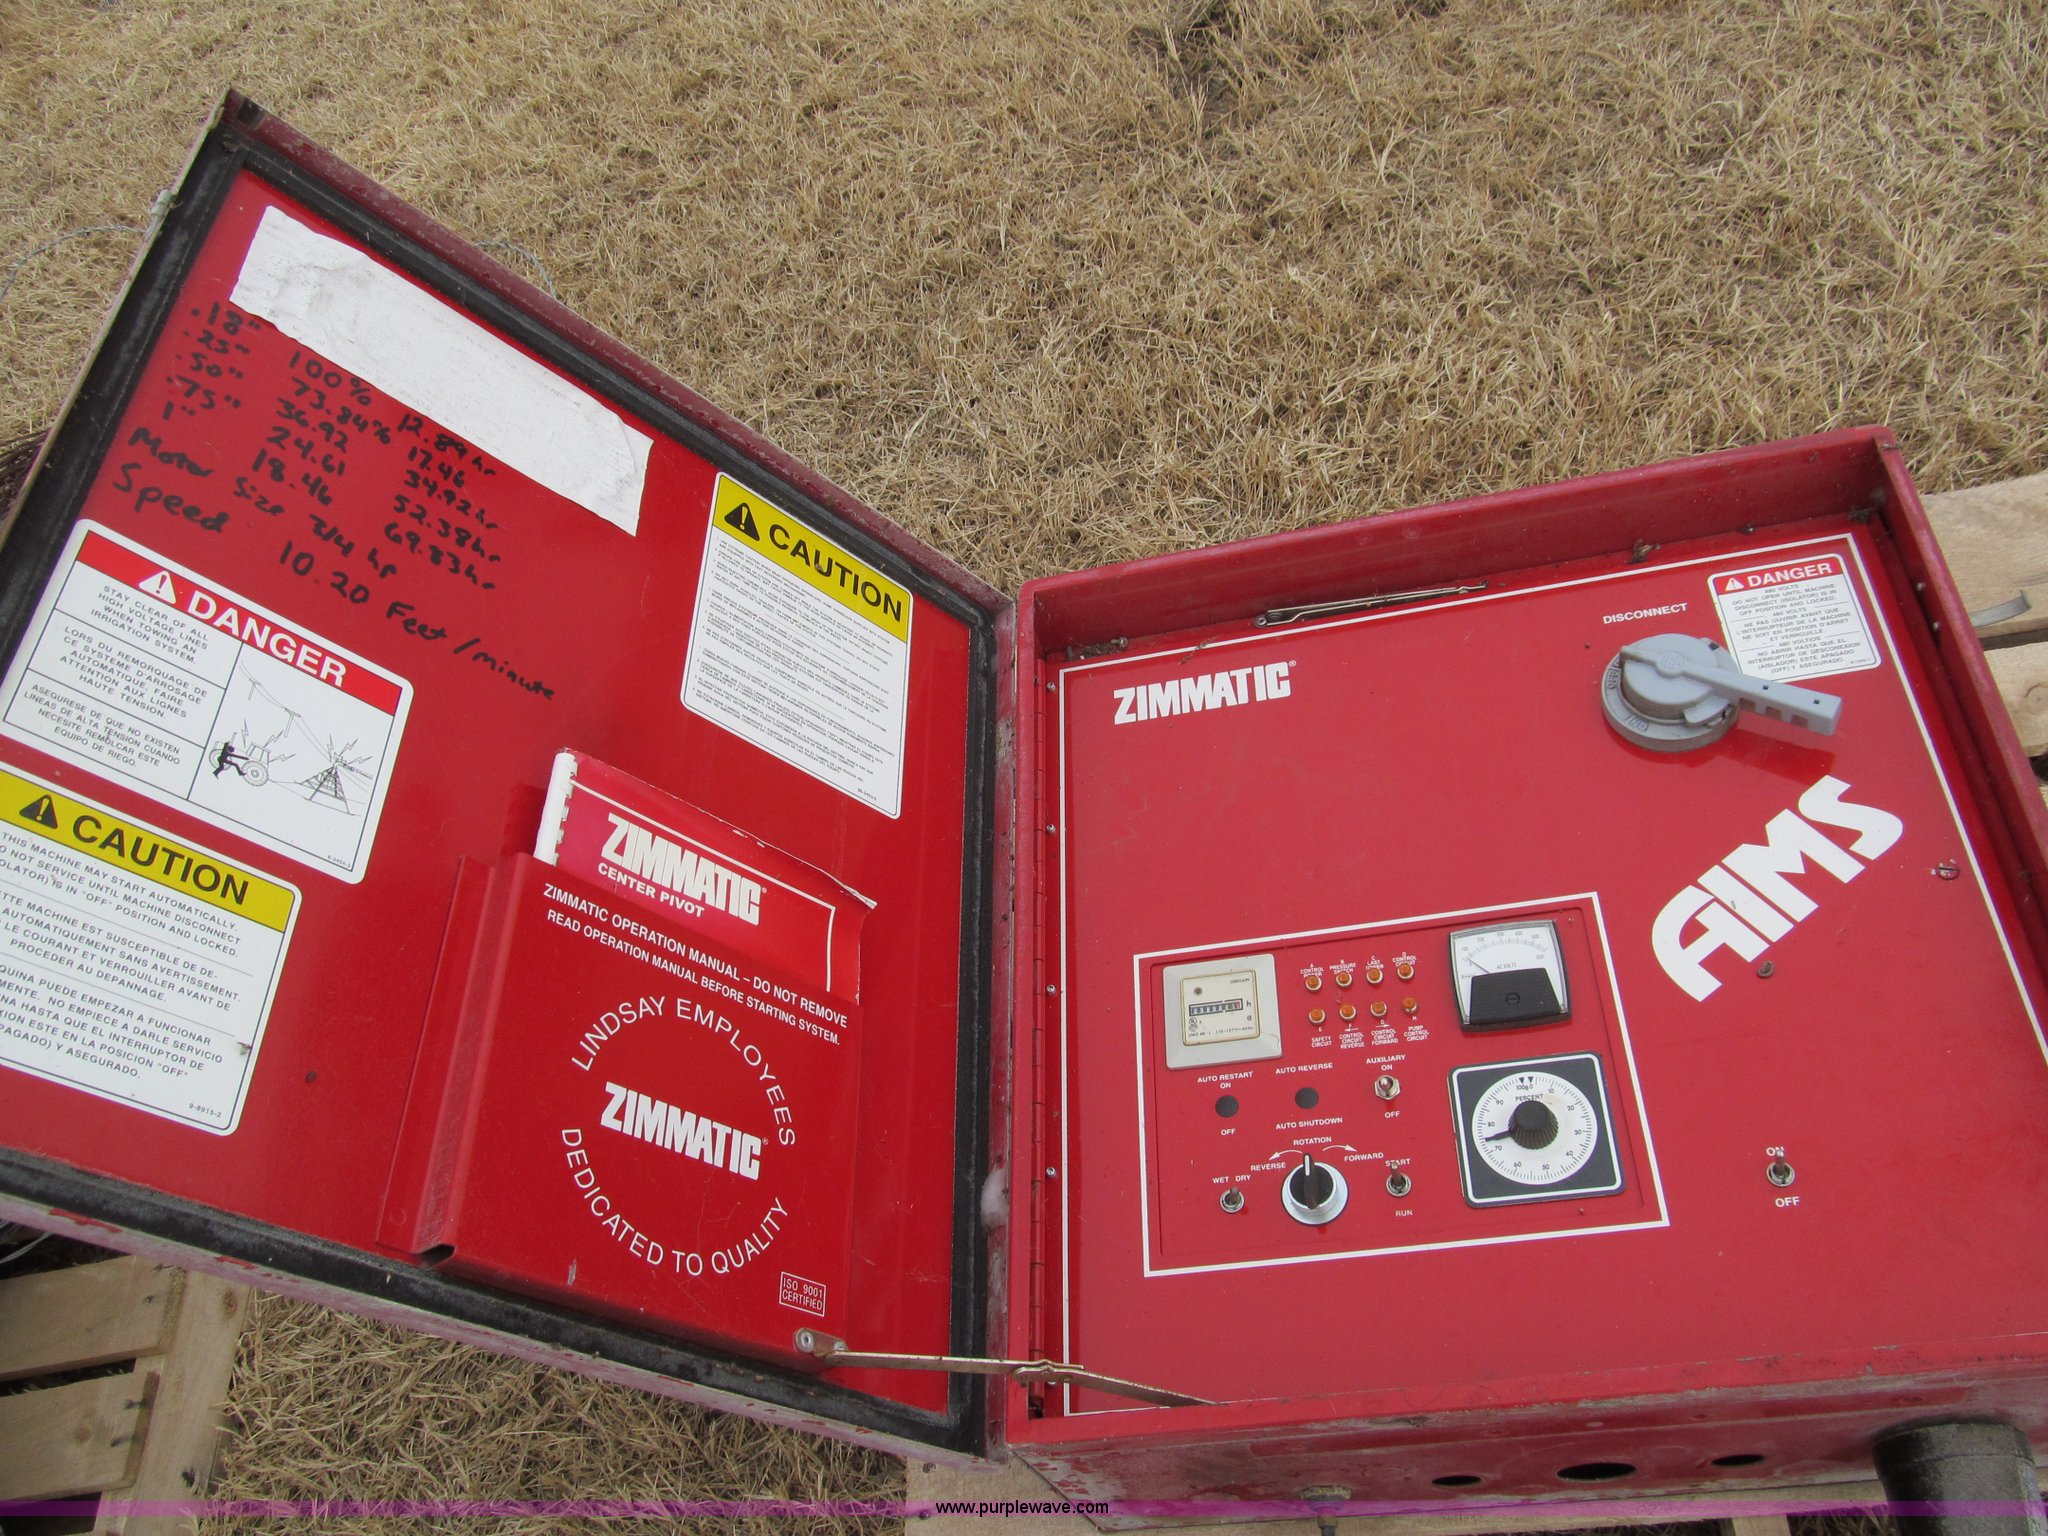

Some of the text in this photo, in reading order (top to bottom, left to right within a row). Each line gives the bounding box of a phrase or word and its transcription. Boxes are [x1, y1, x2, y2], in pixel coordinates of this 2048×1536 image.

[290, 351, 372, 406] 100%
[252, 448, 332, 506] 18.46
[267, 426, 345, 477] 24.61
[113, 462, 230, 533] Speed
[386, 601, 447, 640] Feet
[769, 523, 902, 623] CAUTION
[1748, 562, 1833, 588] DANGER
[90, 609, 196, 664] IRRIGATION SYSTEM.
[98, 592, 208, 650] HIGH VOLTAGE LINES
[103, 585, 208, 642] STAY CLEAR OF ALL
[104, 604, 197, 654] WHEN TOWING AN
[187, 589, 348, 689] DANGER
[1603, 602, 1689, 624] DISCONNECT
[31, 684, 180, 755] ASEGURESE DE QUE NO EXISTEN
[79, 674, 166, 719] HAUTE TENSION.
[1113, 661, 1291, 725] ZIMMATIC
[54, 726, 137, 768] EQUIPO DE RIEGO.
[2, 831, 28, 848] THIS
[30, 843, 82, 870] MACHINE
[84, 865, 109, 879] MAY
[110, 875, 147, 895] START
[148, 891, 237, 932] AUTOMATICALLY.
[72, 814, 249, 906] CAUTION
[600, 812, 761, 926] ZIMMATIC
[10, 849, 241, 945] NOT SERVICE UNTIL MACHINE DISCONNECT
[598, 862, 705, 918] CENTER PIVOT
[1652, 774, 1904, 1002] AIMS
[52, 875, 238, 958] IS IN "OFF" POSITION AND LOCKED.
[10, 938, 166, 1002] PROCEDER AU DEPANNAGE.
[543, 883, 848, 1029] ZIMMATIC OPERATION MANUAL DO NOT REMOVE
[547, 909, 841, 1046] READ OPERATION MANUAL BEFORE STARTING SYSTEM.
[571, 996, 796, 1146] LINDSAY EMPLOYEES
[1197, 1070, 1253, 1083] AUTO RESTART
[1275, 1062, 1333, 1074] AUTO REVERSE
[1366, 1054, 1406, 1064] AUXILIARY
[1275, 1117, 1343, 1130] AUTO SHUTDOWN
[1385, 1111, 1400, 1119] OFF
[1515, 1094, 1544, 1102] PERCENT
[600, 1081, 762, 1180] ZIMMATIC
[1220, 1128, 1236, 1136] OFF
[1293, 1136, 1332, 1146] ROTATION
[1344, 1152, 1384, 1162] FORWARD
[1212, 1174, 1251, 1184] WET DRY
[1250, 1162, 1286, 1171] REVERSE
[561, 1128, 789, 1276] DEDICATED TO QUALITY
[1395, 1209, 1413, 1217] RUN
[1775, 1196, 1800, 1207] OFF
[782, 1277, 824, 1298] ISO 9001
[782, 1290, 824, 1311] CERTIFIED
